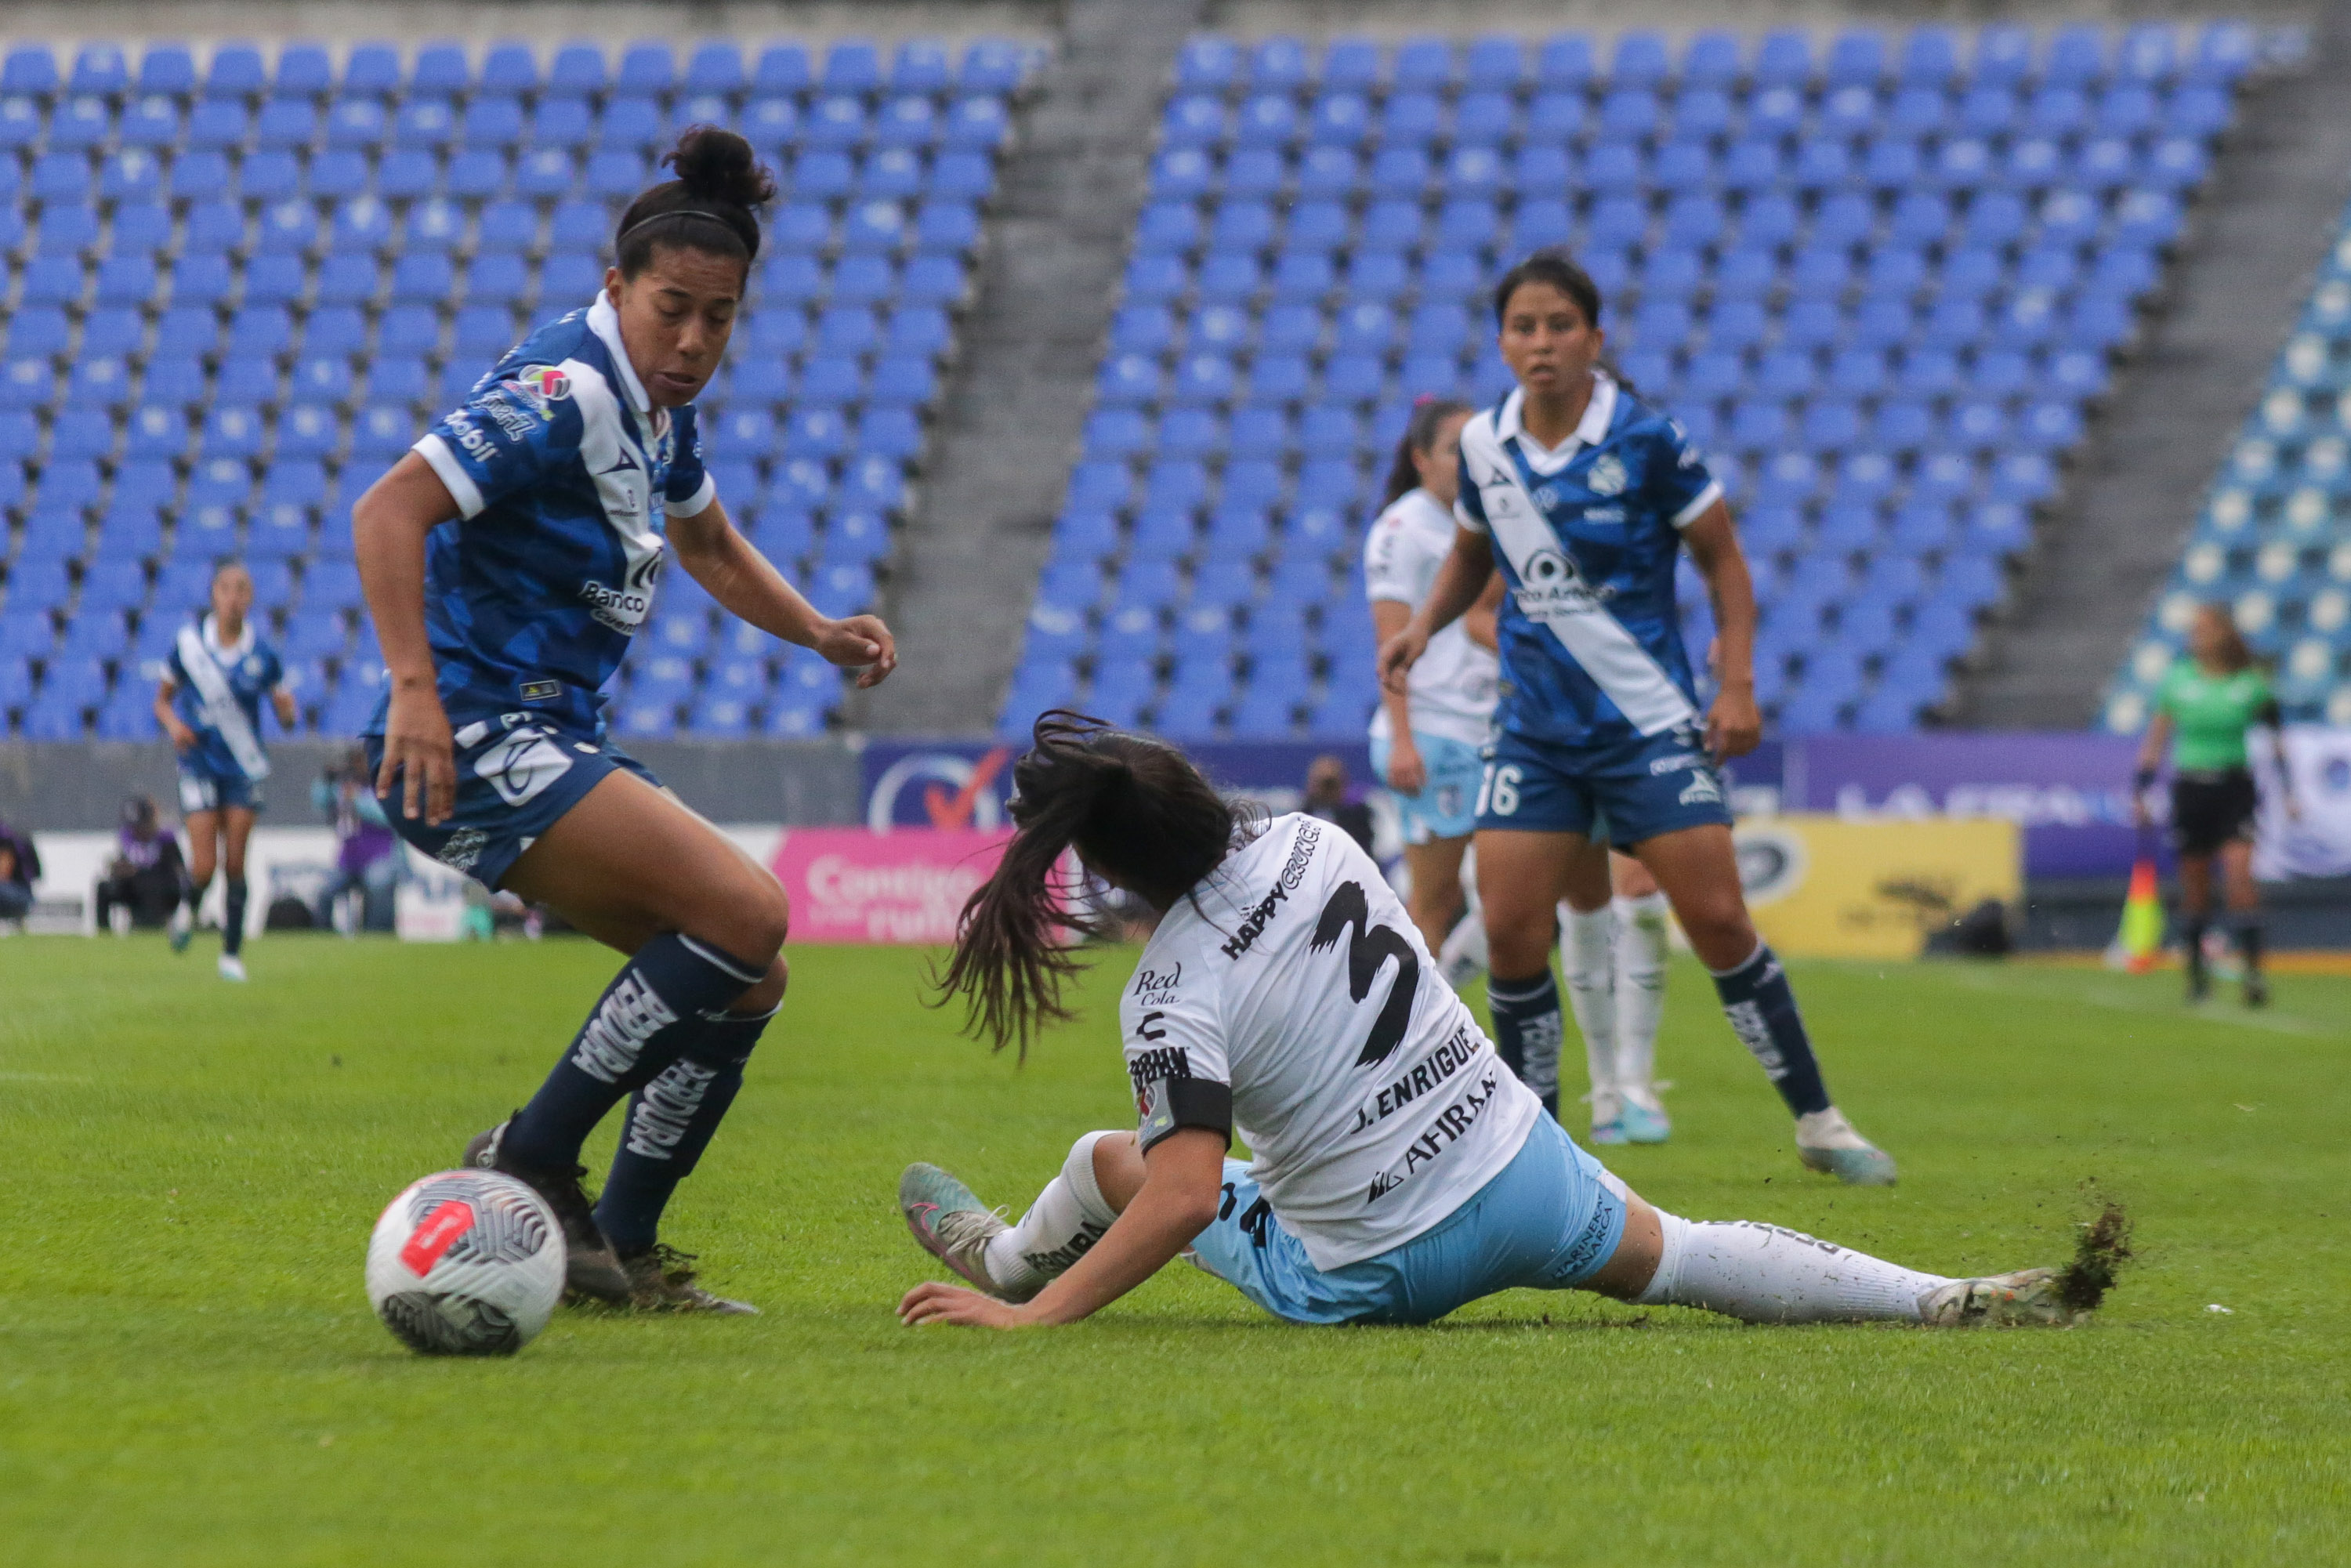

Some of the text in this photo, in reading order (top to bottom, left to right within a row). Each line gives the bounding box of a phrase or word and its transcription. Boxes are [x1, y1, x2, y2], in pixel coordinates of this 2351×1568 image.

[581, 580, 644, 614] Banco
[1474, 765, 1523, 817] 16
[1131, 961, 1183, 998] Red
[1310, 880, 1423, 1070] 3
[1140, 990, 1180, 1006] Cola
